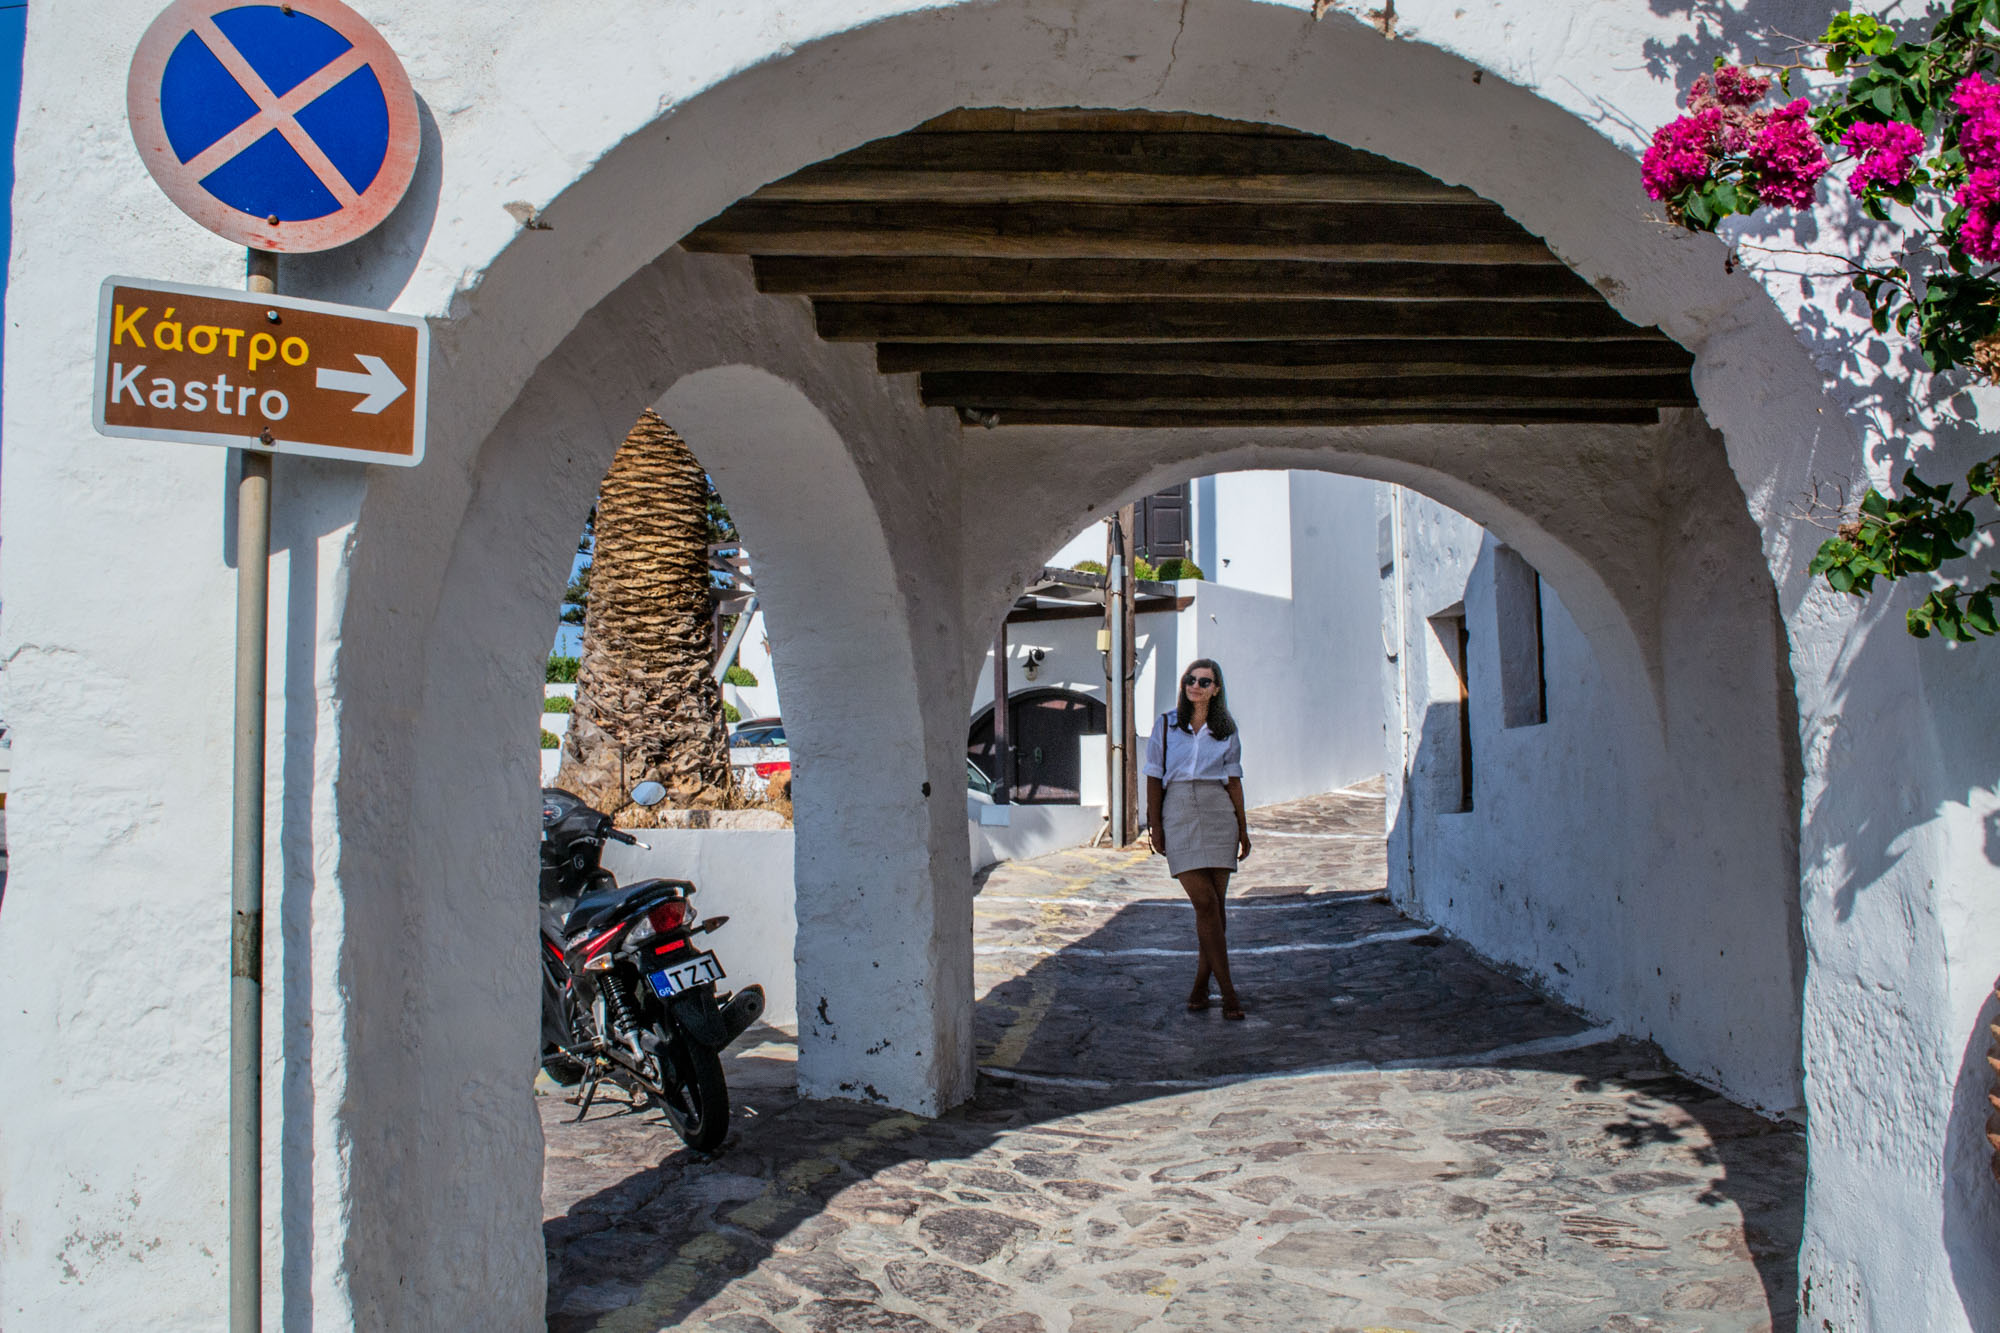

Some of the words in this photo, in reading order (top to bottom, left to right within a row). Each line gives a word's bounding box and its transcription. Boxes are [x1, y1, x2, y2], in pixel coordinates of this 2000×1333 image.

[112, 304, 310, 371] Κάστρο
[111, 363, 289, 421] Kastro
[659, 987, 672, 997] GR
[668, 959, 715, 990] TZT
